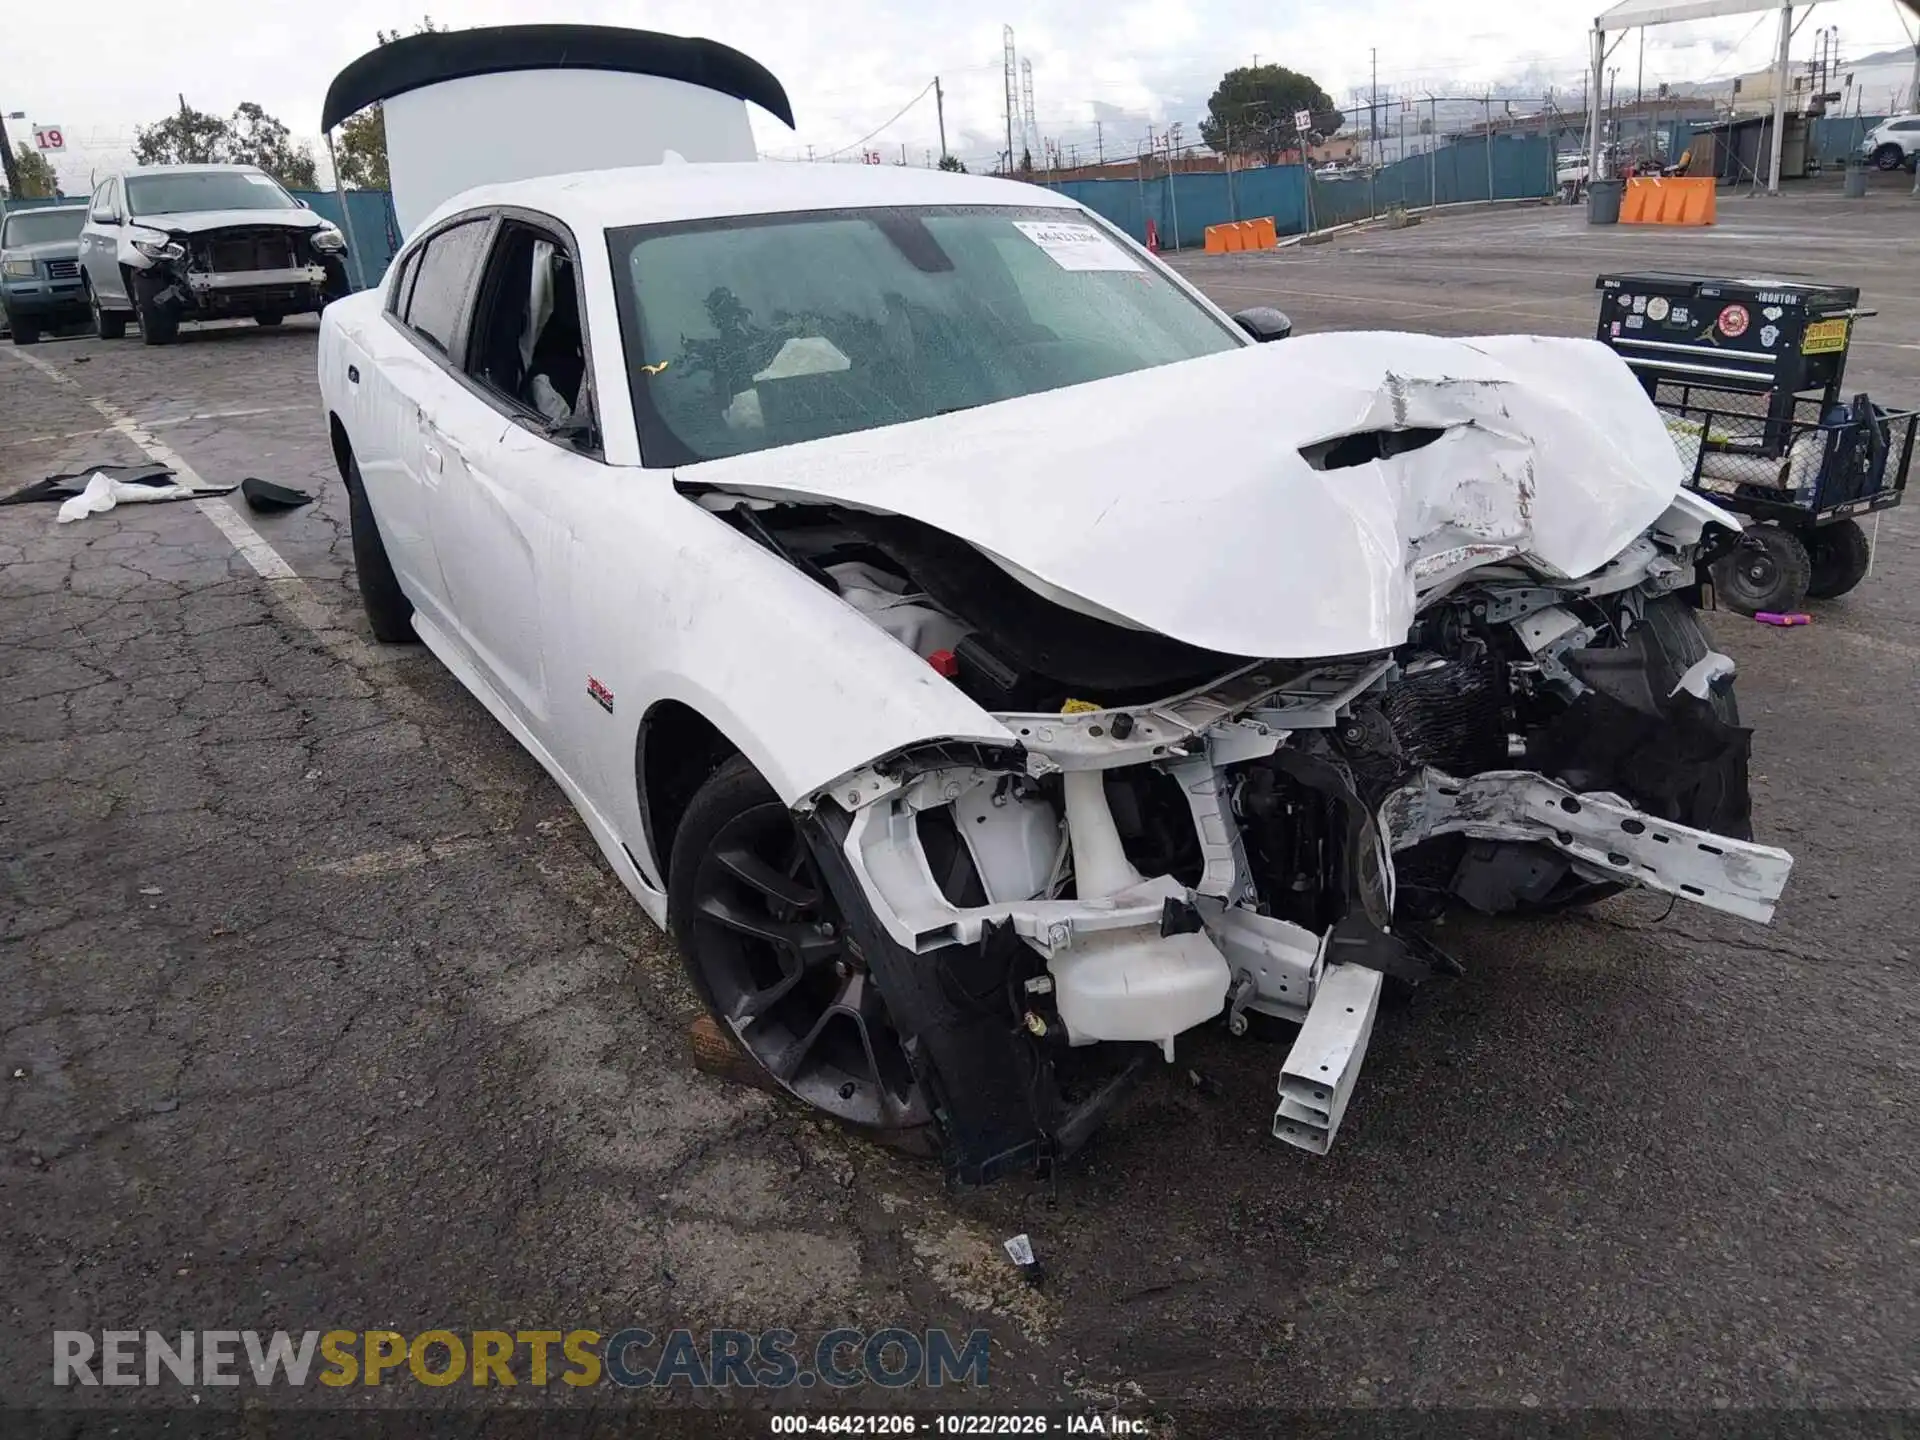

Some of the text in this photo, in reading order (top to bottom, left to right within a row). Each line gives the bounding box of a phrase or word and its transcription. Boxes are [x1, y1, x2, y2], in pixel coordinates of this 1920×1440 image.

[1296, 113, 1310, 127] 12
[35, 130, 63, 149] 19
[863, 152, 881, 165] 15
[1758, 291, 1797, 305] IRONTON
